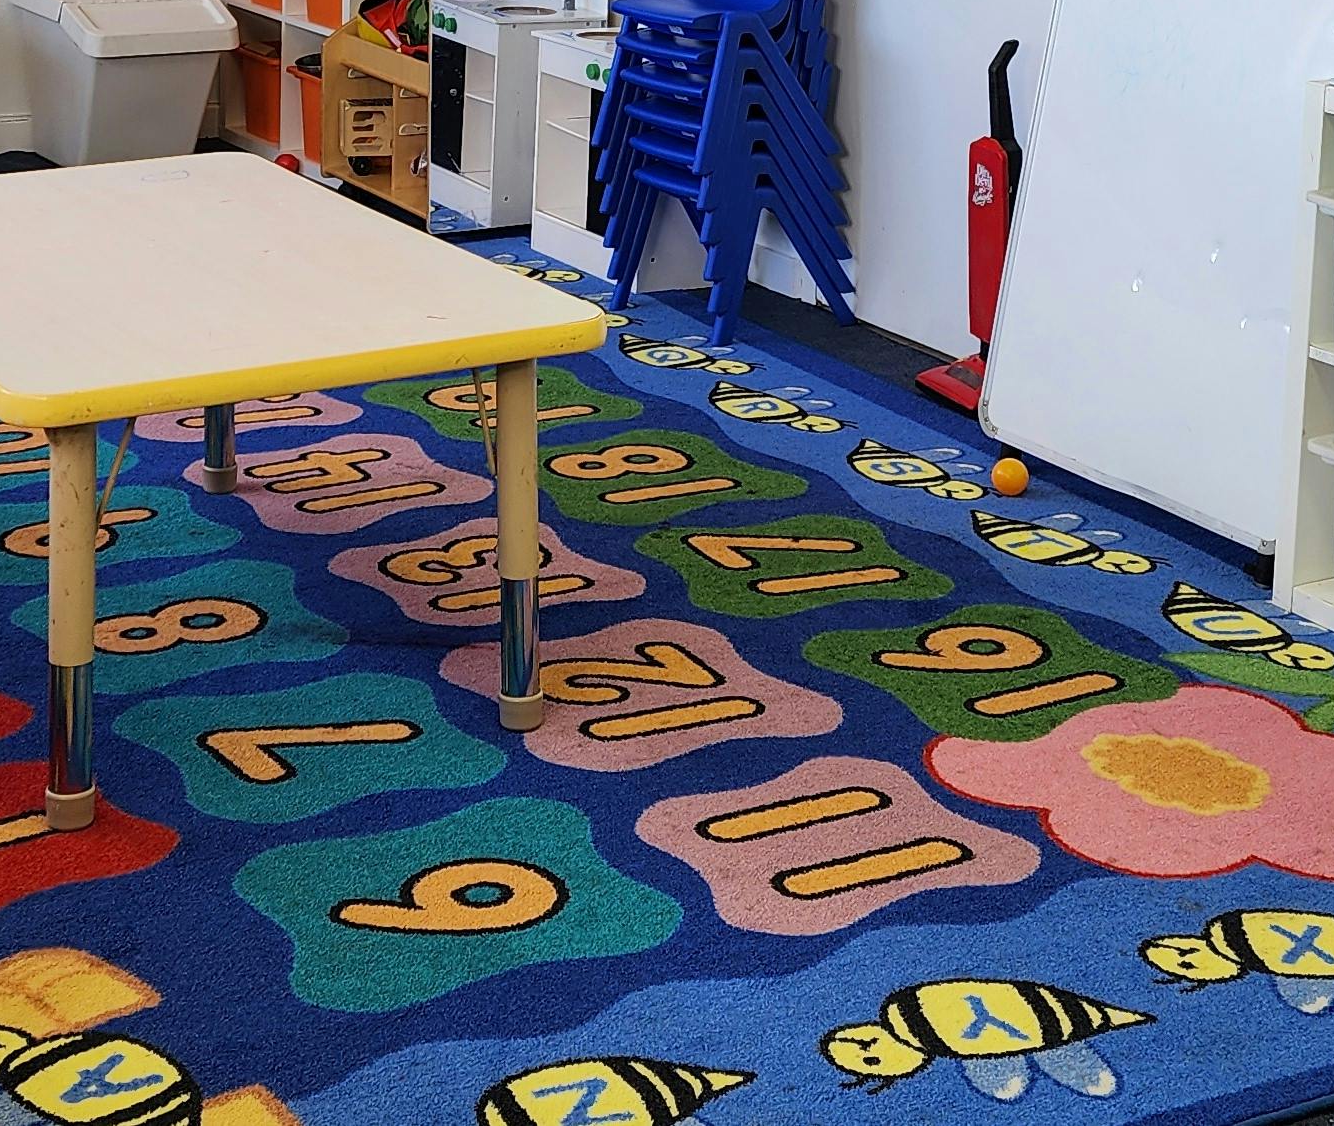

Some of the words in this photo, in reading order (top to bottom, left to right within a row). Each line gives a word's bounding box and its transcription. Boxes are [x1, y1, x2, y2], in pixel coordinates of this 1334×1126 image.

[734, 396, 781, 416] R
[243, 447, 446, 514] 14
[544, 443, 743, 506] 18
[870, 457, 921, 478] S
[679, 532, 910, 596] 17
[1006, 528, 1059, 557] T
[94, 596, 267, 655] 8
[1192, 615, 1262, 635] U
[872, 622, 1126, 719] 16
[195, 719, 424, 784] 7
[695, 785, 975, 902] 11
[960, 994, 1031, 1041] Y
[59, 1051, 165, 1103] A
